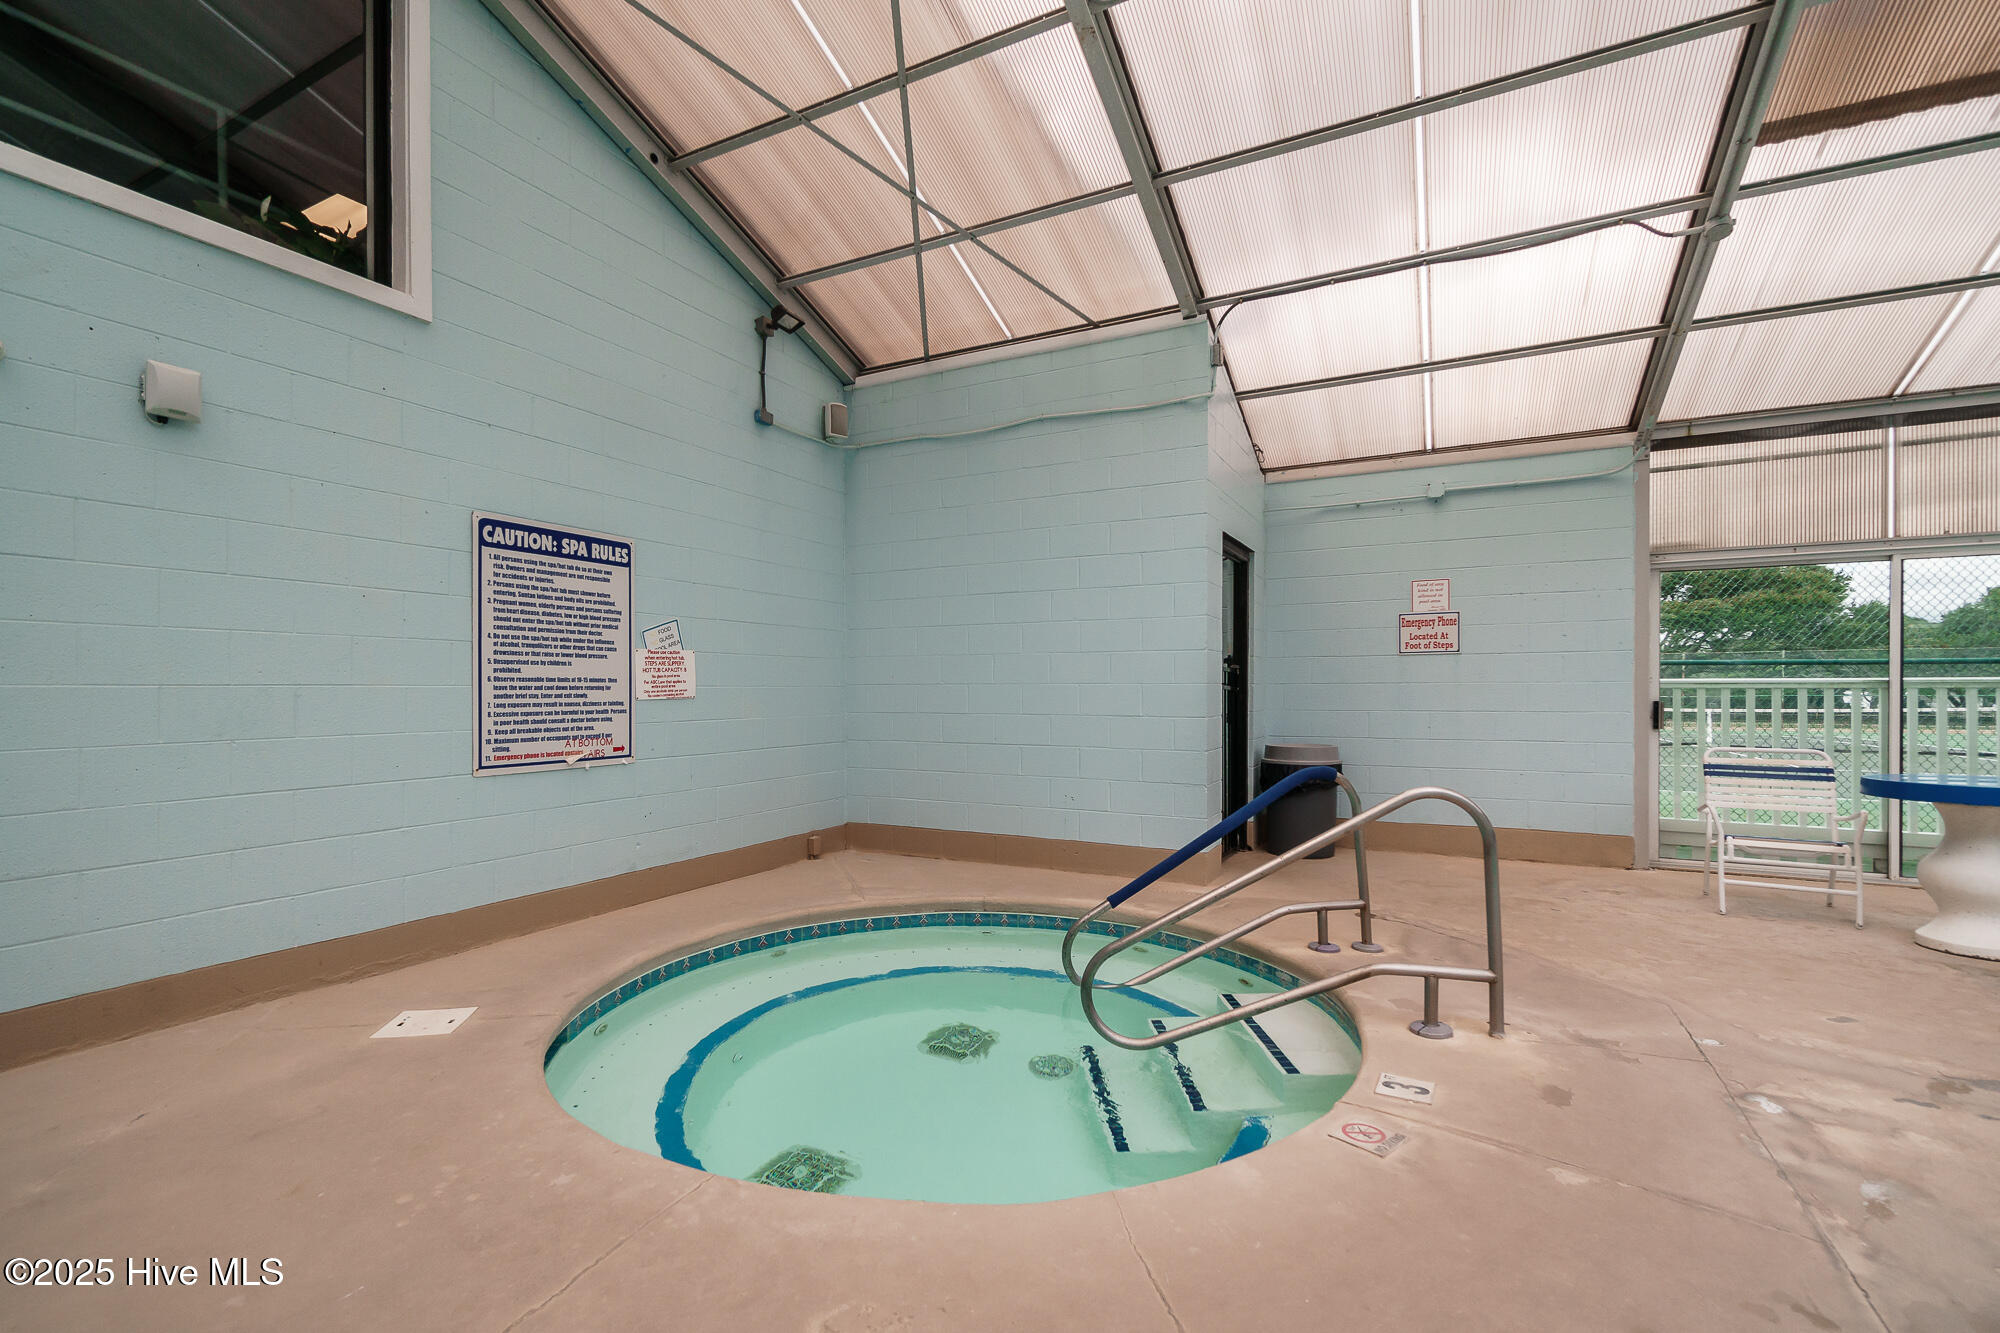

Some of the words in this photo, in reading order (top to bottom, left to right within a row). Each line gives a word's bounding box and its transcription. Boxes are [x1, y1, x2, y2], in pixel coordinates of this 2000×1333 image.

[482, 525, 557, 552] CAUTION:
[561, 538, 588, 557] SPA
[592, 543, 628, 563] RULES
[1401, 618, 1436, 629] Emergency
[1438, 616, 1457, 626] Phone
[658, 626, 672, 634] FOOD
[659, 633, 674, 643] GLASS
[1410, 632, 1438, 640] Located
[668, 639, 680, 648] AREA
[1433, 642, 1454, 650] Steps
[564, 739, 576, 748] AT
[578, 737, 613, 747] BOTTOM
[493, 753, 522, 762] Emergency
[524, 752, 539, 760] phone
[584, 749, 605, 758] AIRS
